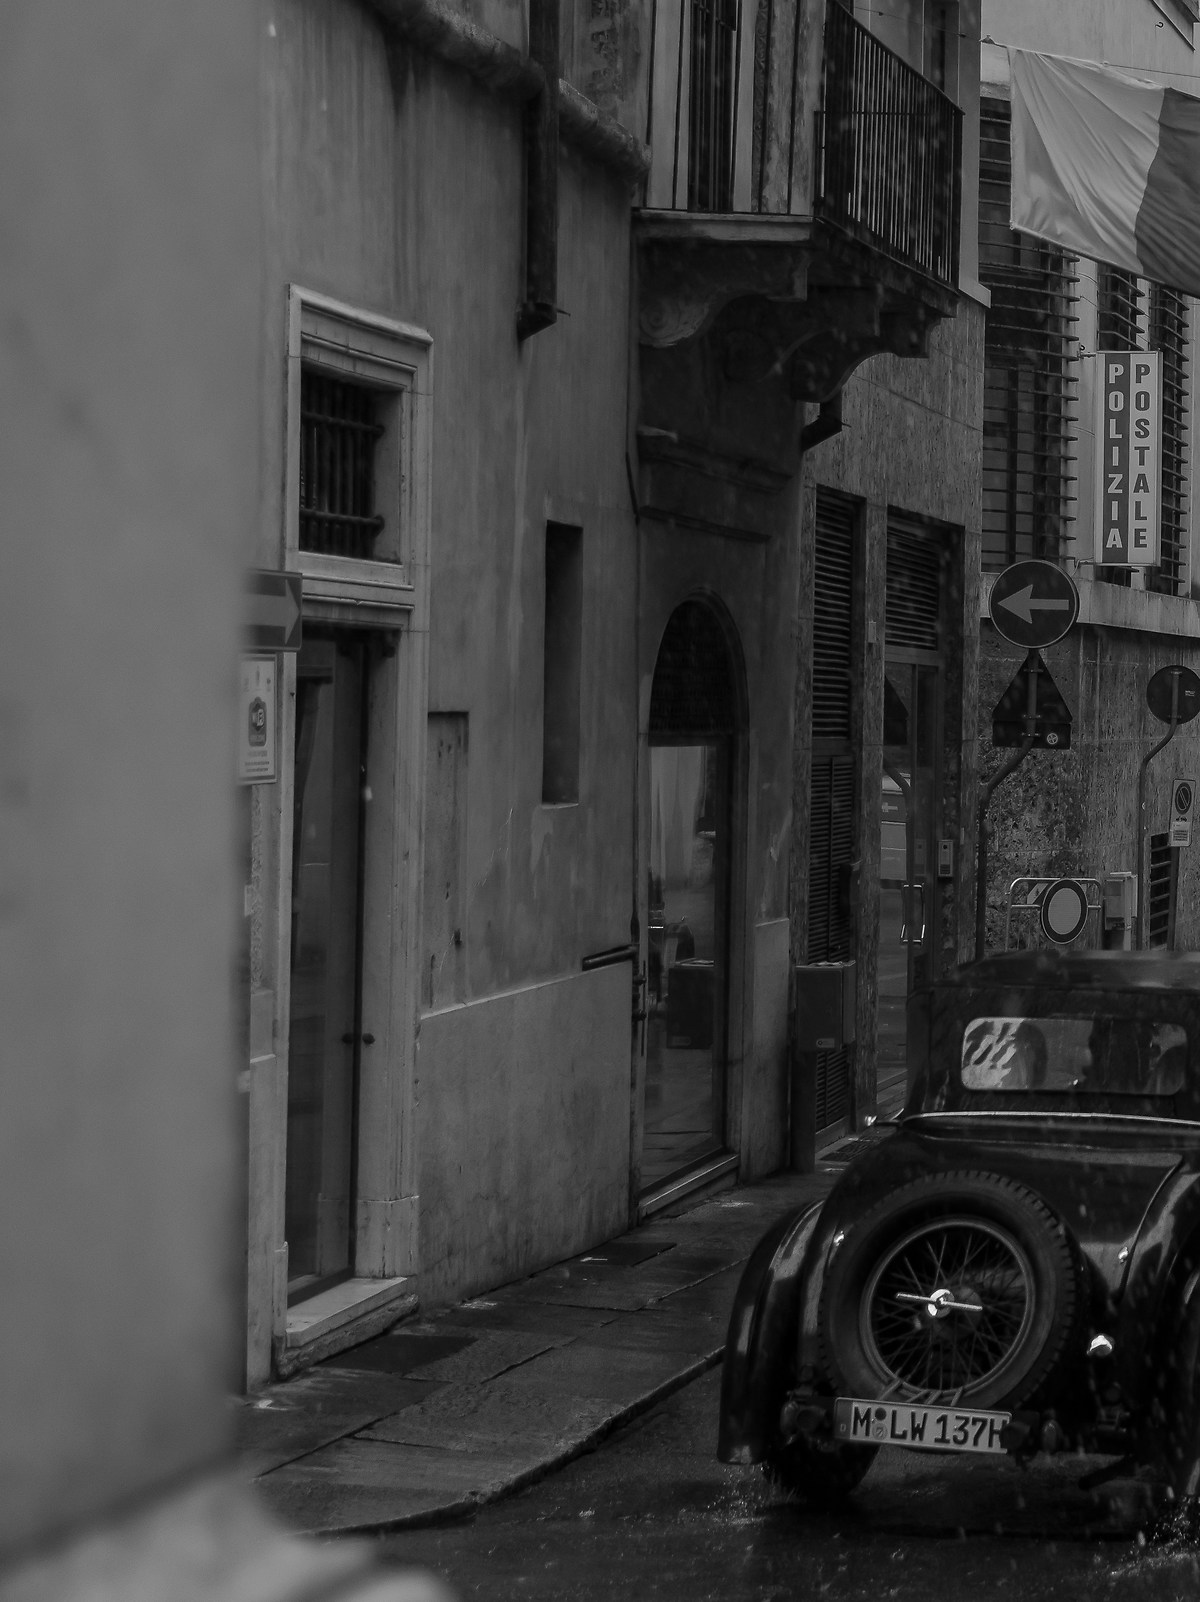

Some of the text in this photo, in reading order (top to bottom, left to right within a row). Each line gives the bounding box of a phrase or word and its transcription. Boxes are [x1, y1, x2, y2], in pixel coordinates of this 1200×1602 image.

[1106, 363, 1125, 549] POLIZIA
[1133, 363, 1151, 549] POSTALE
[852, 1405, 872, 1436] M
[890, 1409, 928, 1441] LW
